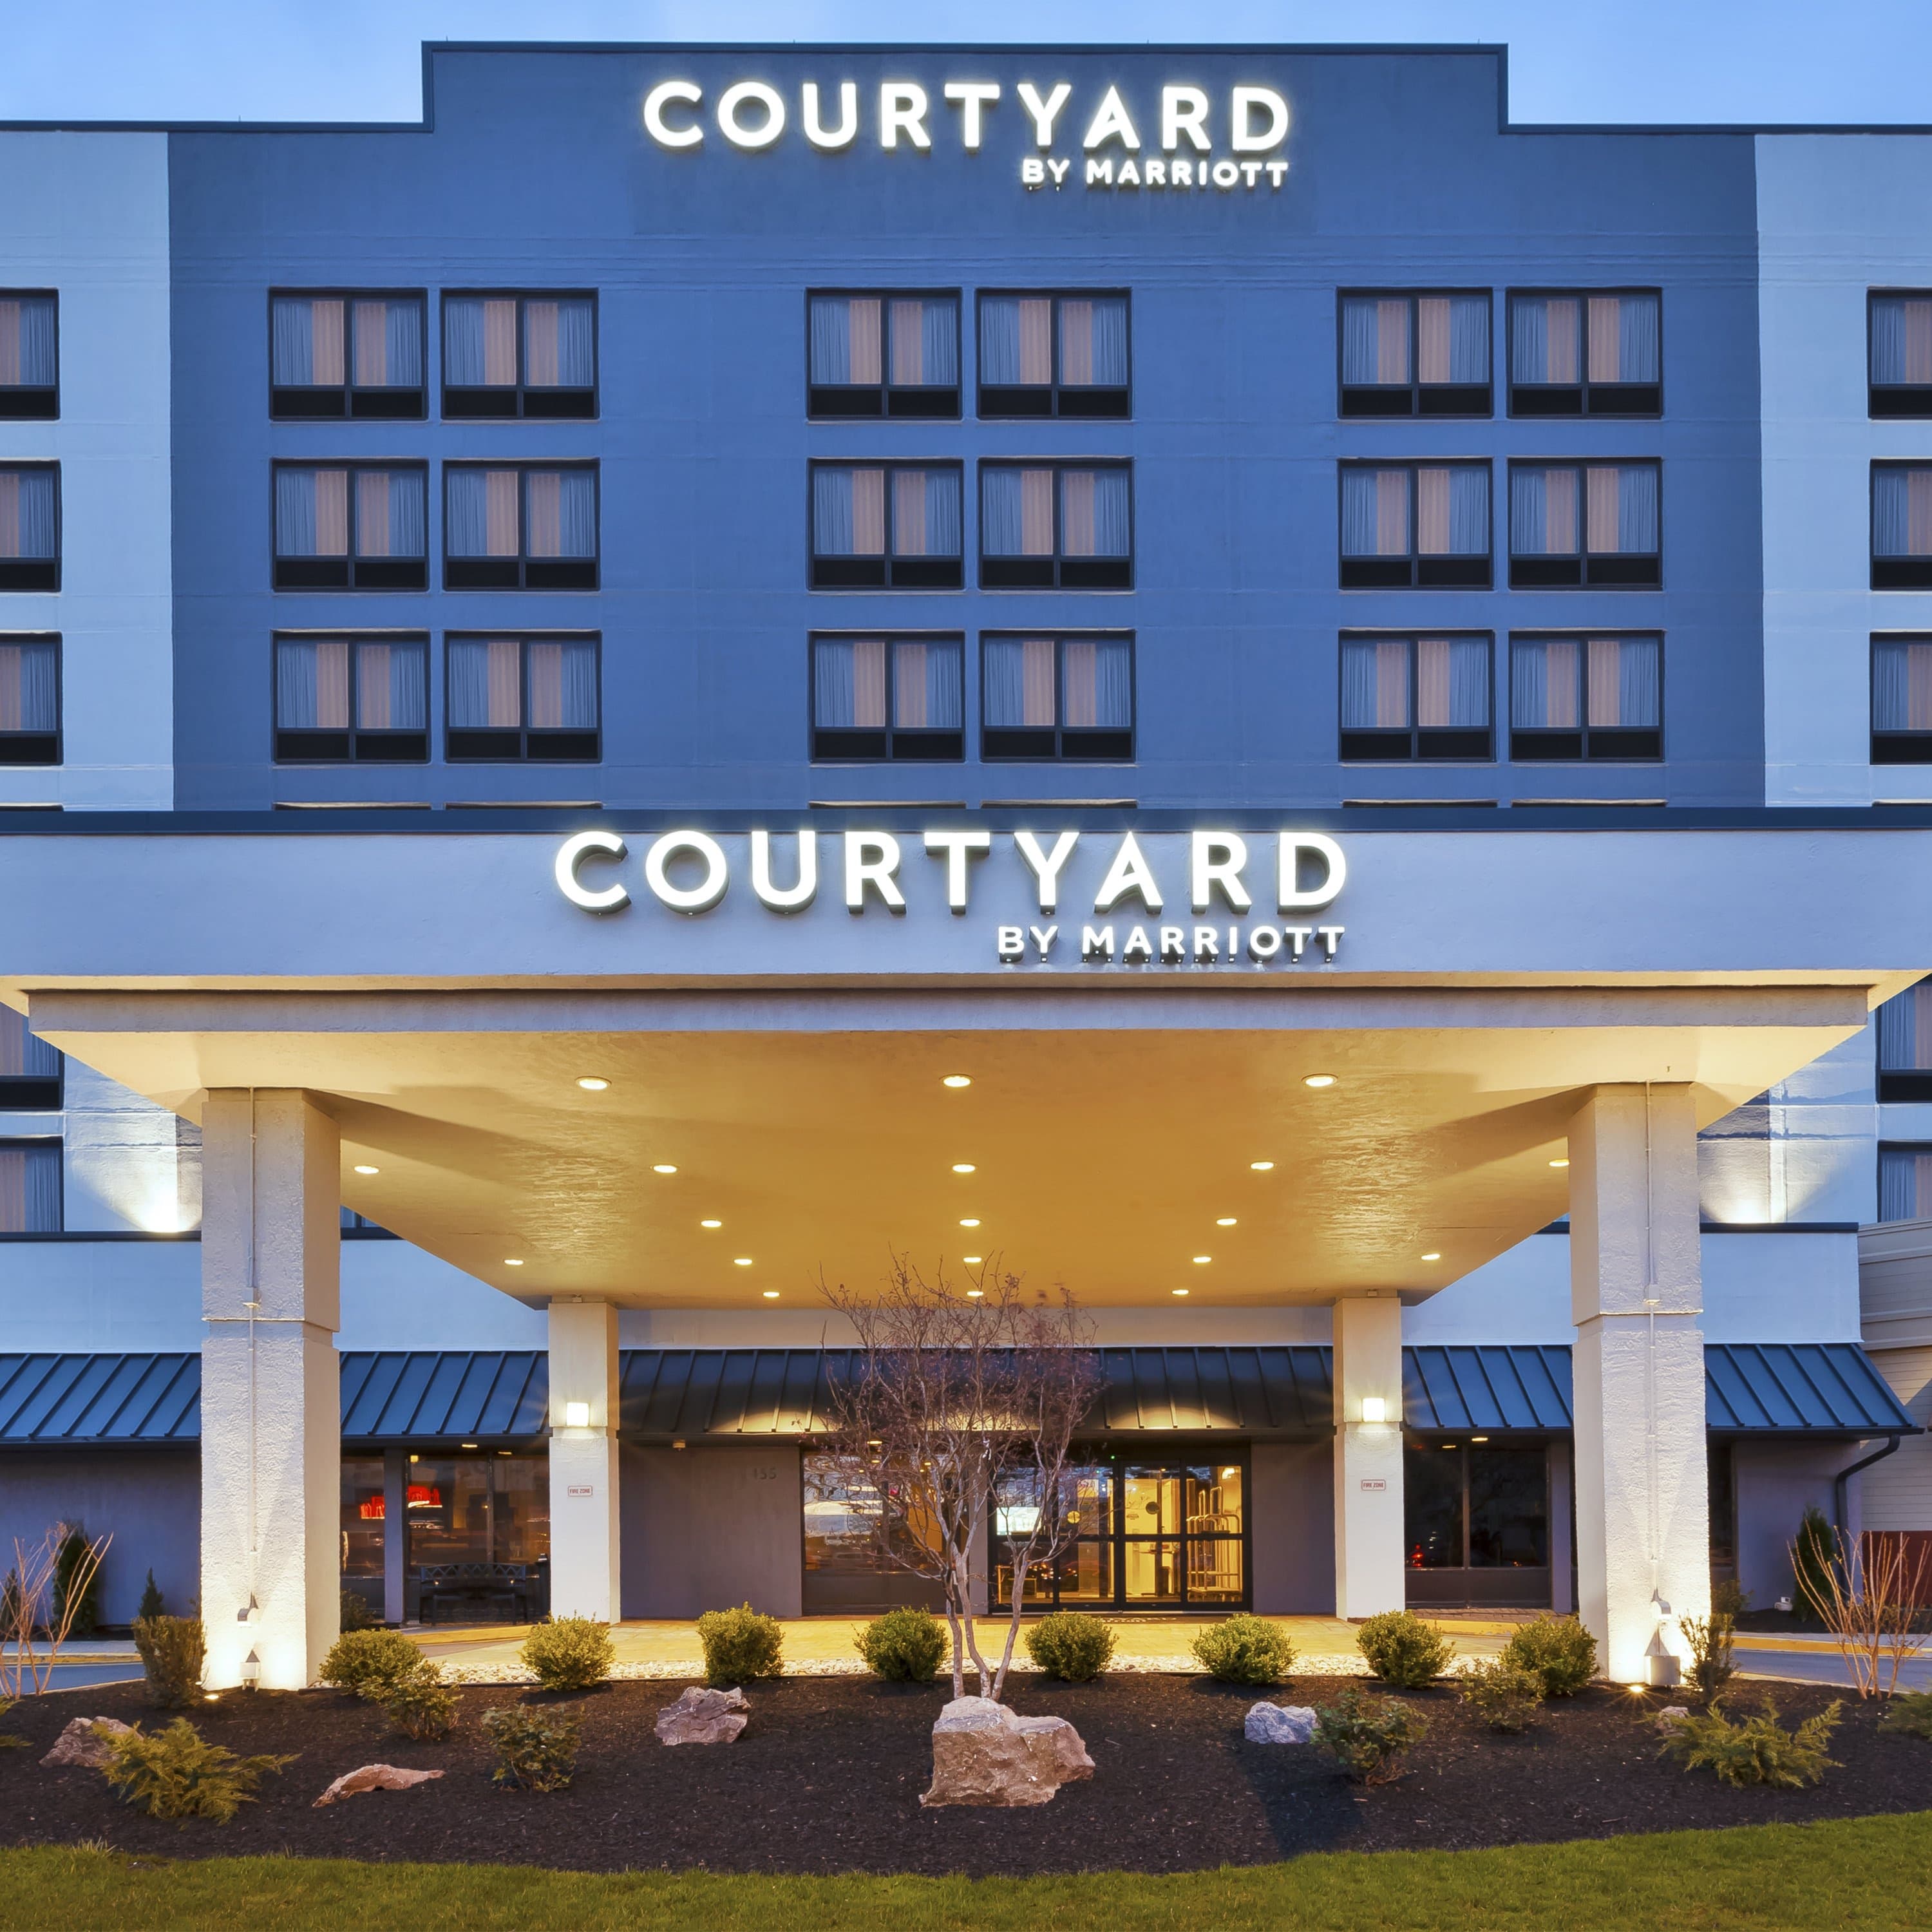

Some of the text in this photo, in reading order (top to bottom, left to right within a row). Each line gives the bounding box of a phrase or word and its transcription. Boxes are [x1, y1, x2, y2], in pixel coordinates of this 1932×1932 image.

[643, 82, 1289, 151] COURTYARD
[1022, 159, 1289, 186] BY MARRIOTT
[554, 830, 1347, 910] COURTYARD
[998, 925, 1345, 958] BY MARRIOTT
